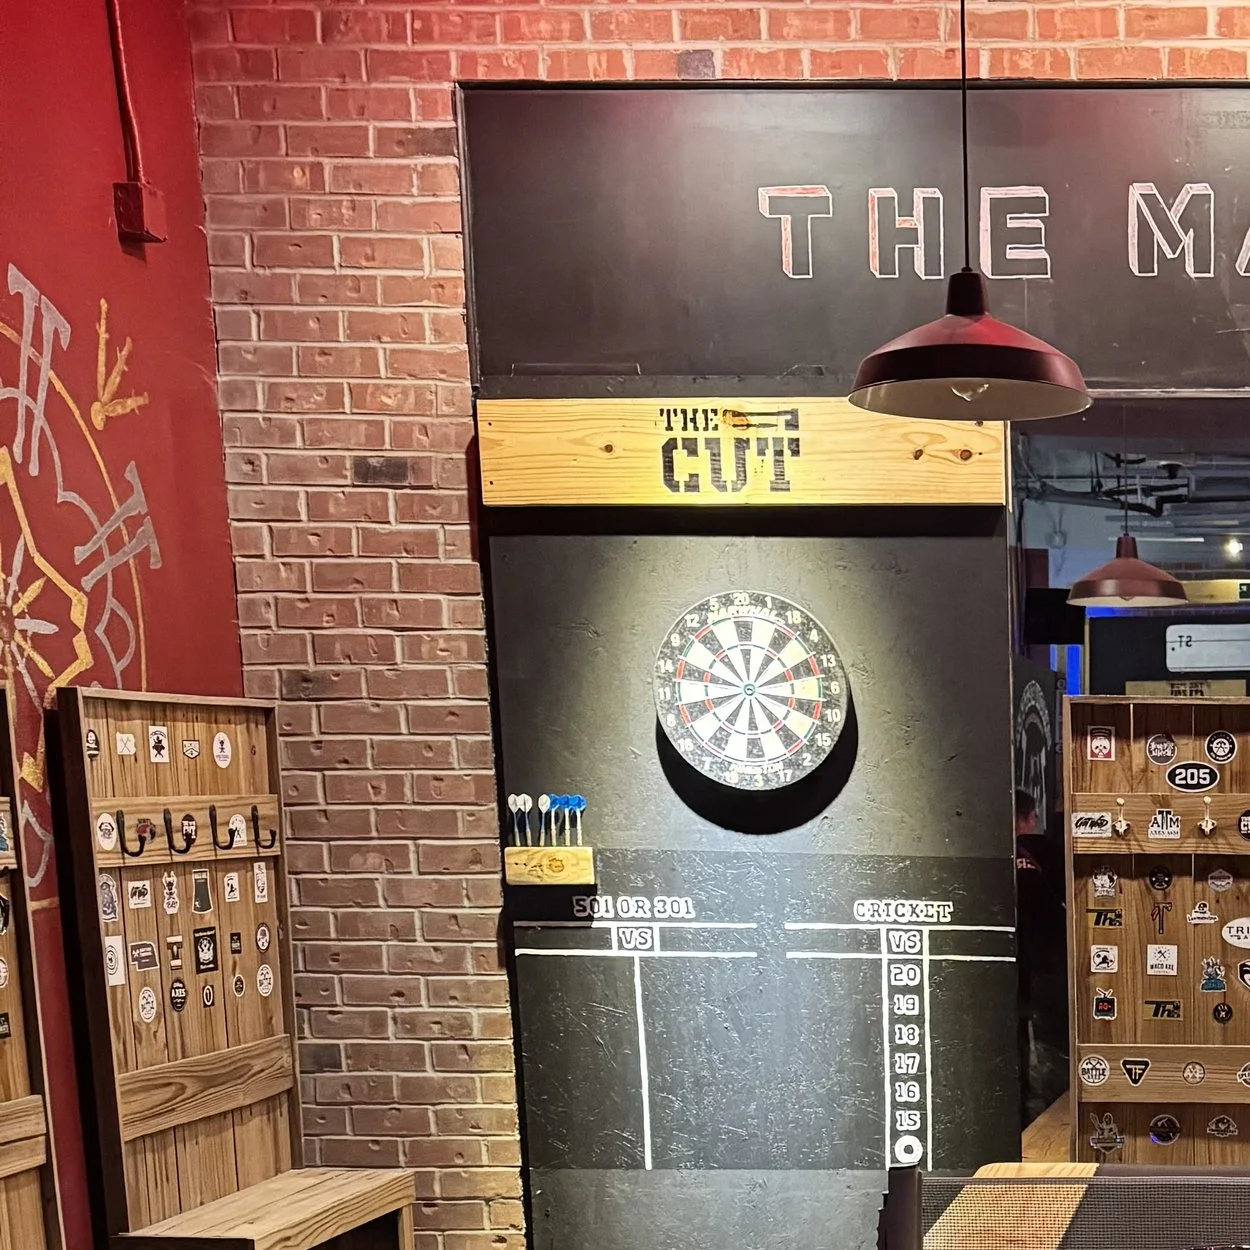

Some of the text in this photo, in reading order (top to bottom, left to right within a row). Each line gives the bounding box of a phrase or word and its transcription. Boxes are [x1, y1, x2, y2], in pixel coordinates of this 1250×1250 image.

[757, 184, 1052, 280] THE
[659, 408, 719, 431] THE
[661, 437, 801, 492] CUT
[709, 598, 719, 610] 5
[765, 597, 772, 608] 1
[685, 614, 700, 627] 12
[786, 611, 801, 624] 18
[671, 633, 681, 647] 9
[810, 629, 819, 642] 4
[658, 661, 674, 673] 14
[821, 655, 836, 667] 13
[658, 687, 671, 700] 11
[831, 681, 840, 694] 6
[667, 714, 676, 727] 8
[826, 709, 841, 722] 10
[678, 739, 694, 752] 16
[816, 733, 831, 746] 15
[704, 757, 712, 770] 7
[803, 753, 812, 766] 2
[779, 770, 793, 782] 17
[1175, 768, 1211, 785] 205
[573, 896, 696, 918] 501 OR 301
[854, 900, 953, 922] CRICKET
[619, 928, 653, 949] VS
[889, 931, 921, 953] VS
[890, 964, 920, 986] 20
[171, 988, 186, 998] AXES
[894, 995, 919, 1015] 19
[895, 1024, 919, 1045] 18
[895, 1053, 920, 1074] 17
[1081, 1067, 1106, 1077] BATTLE
[895, 1081, 920, 1102] 16
[895, 1110, 921, 1131] 15
